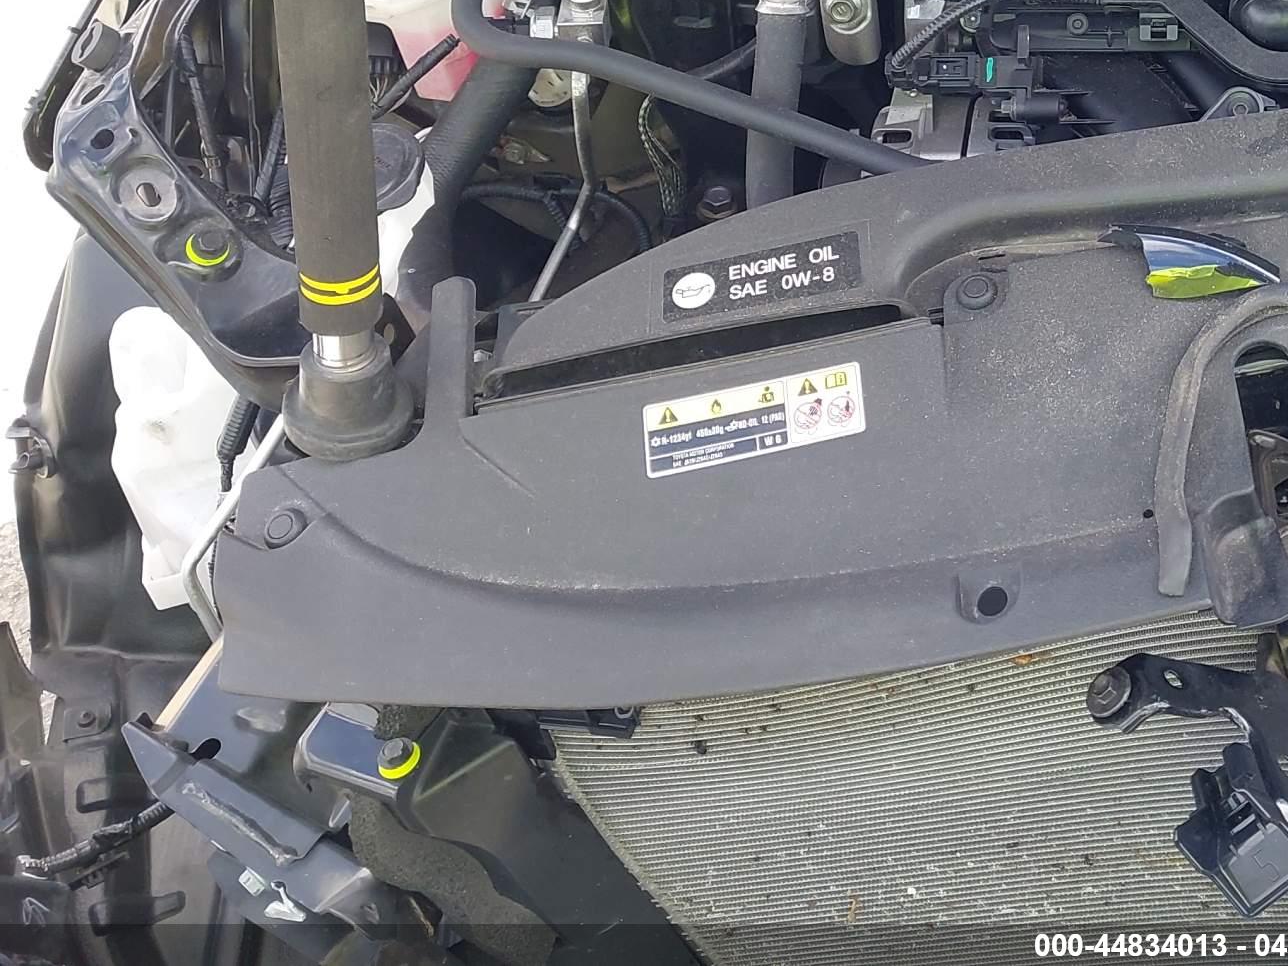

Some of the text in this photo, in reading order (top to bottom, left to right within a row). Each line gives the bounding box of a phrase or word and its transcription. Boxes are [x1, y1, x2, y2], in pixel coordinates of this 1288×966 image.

[728, 245, 840, 280] ENGINE OIL
[729, 266, 835, 300] SAE 0W-8
